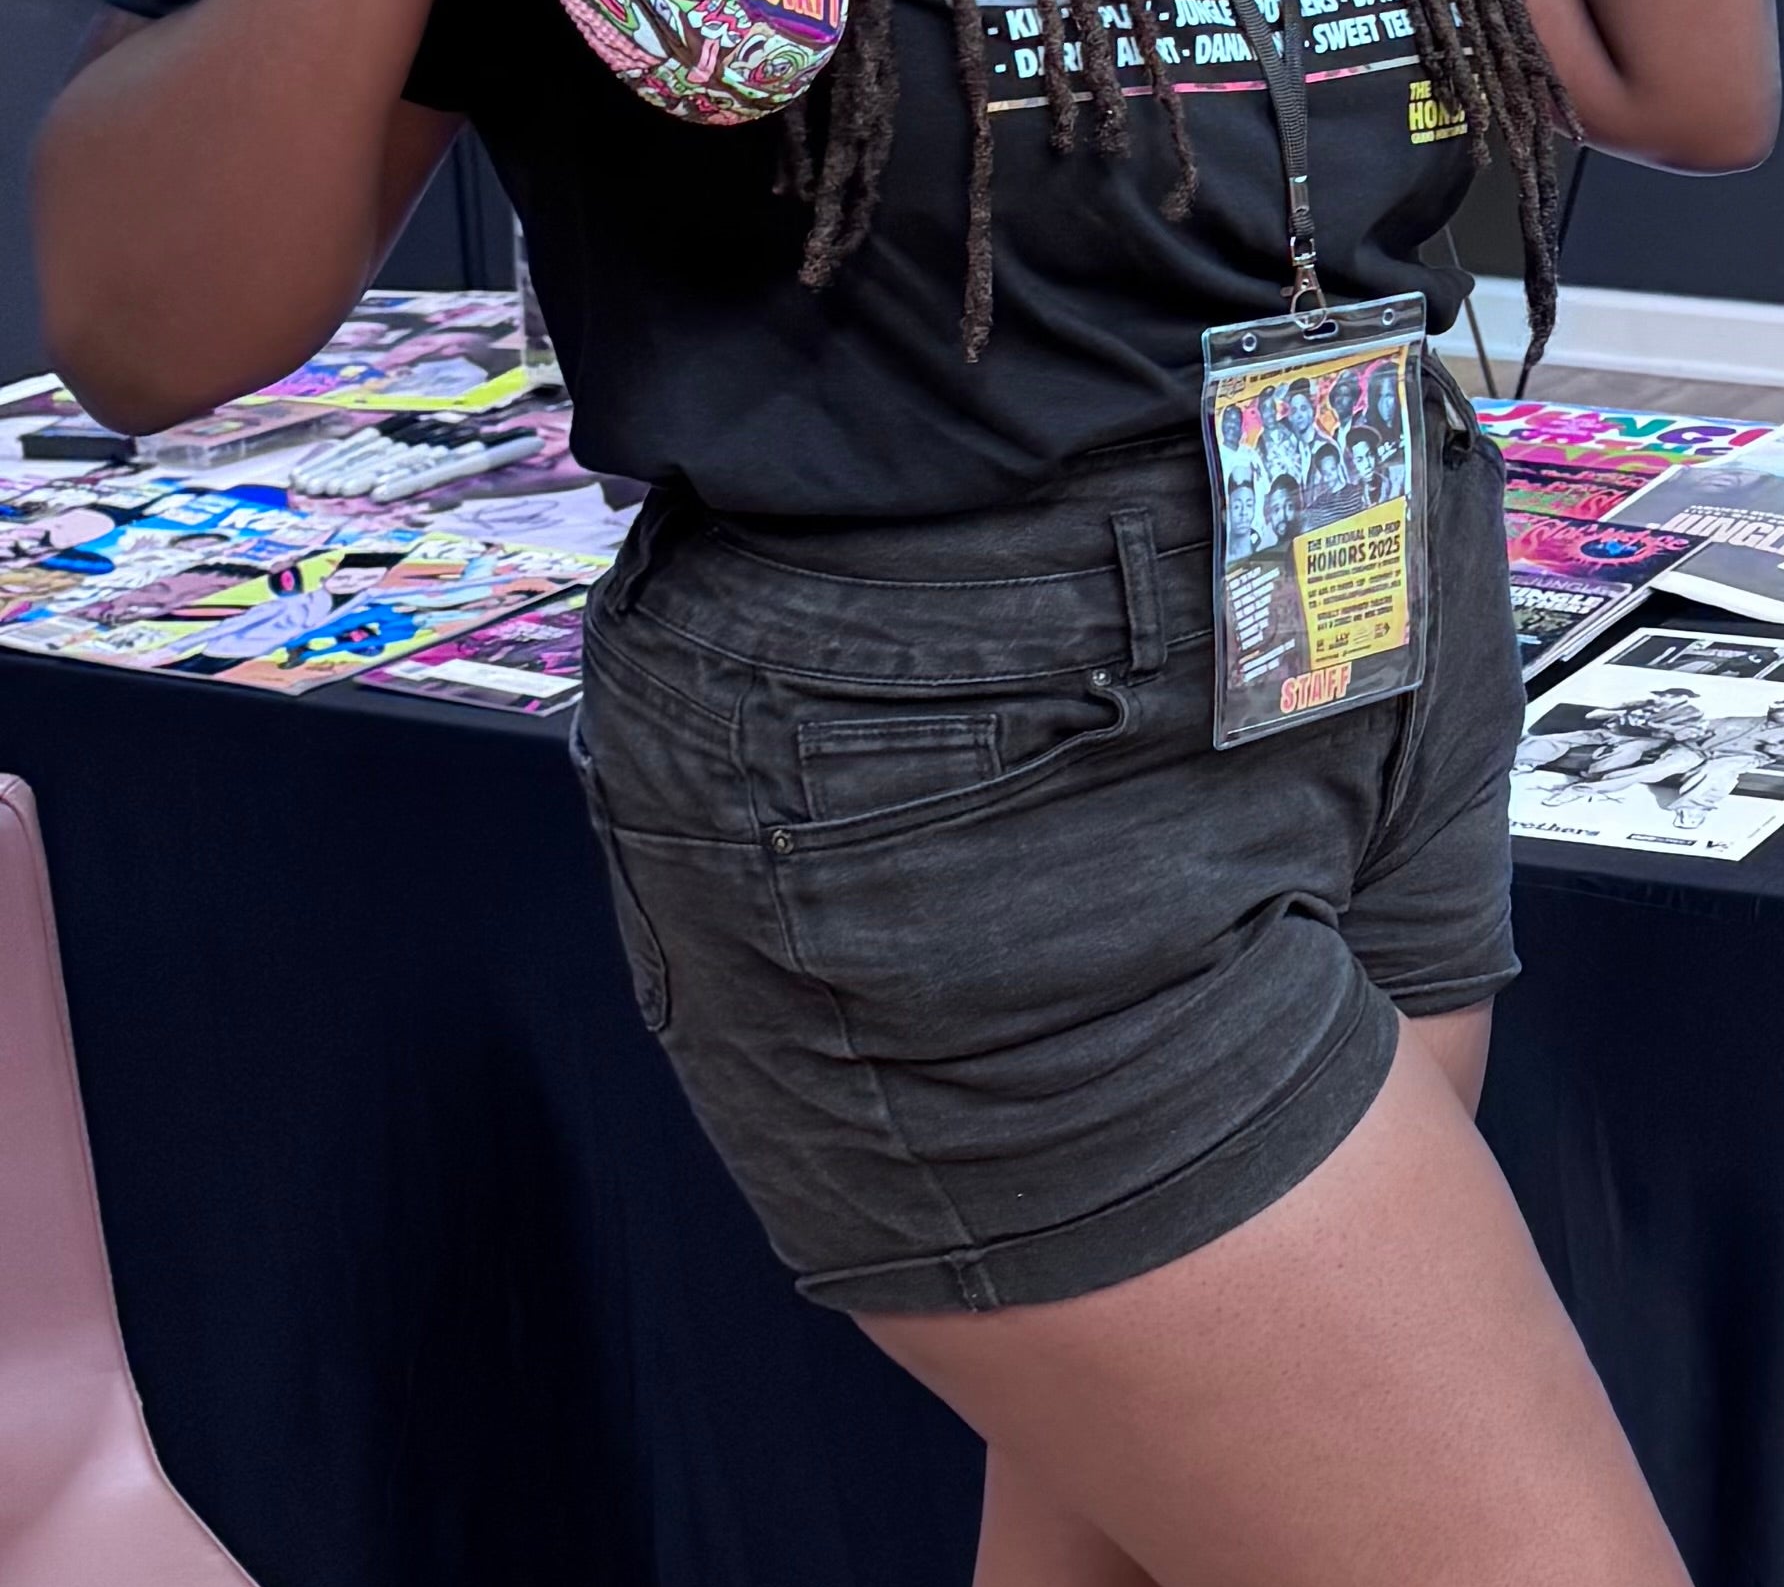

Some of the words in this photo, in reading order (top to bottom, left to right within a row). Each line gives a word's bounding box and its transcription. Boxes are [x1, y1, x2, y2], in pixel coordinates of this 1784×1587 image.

[1312, 14, 1381, 55] SWEET
[1409, 79, 1432, 101] THE
[1307, 542, 1367, 575] HONORS
[1368, 534, 1402, 561] 2025
[1280, 661, 1353, 714] STAFF
[1510, 818, 1601, 838] rothers
